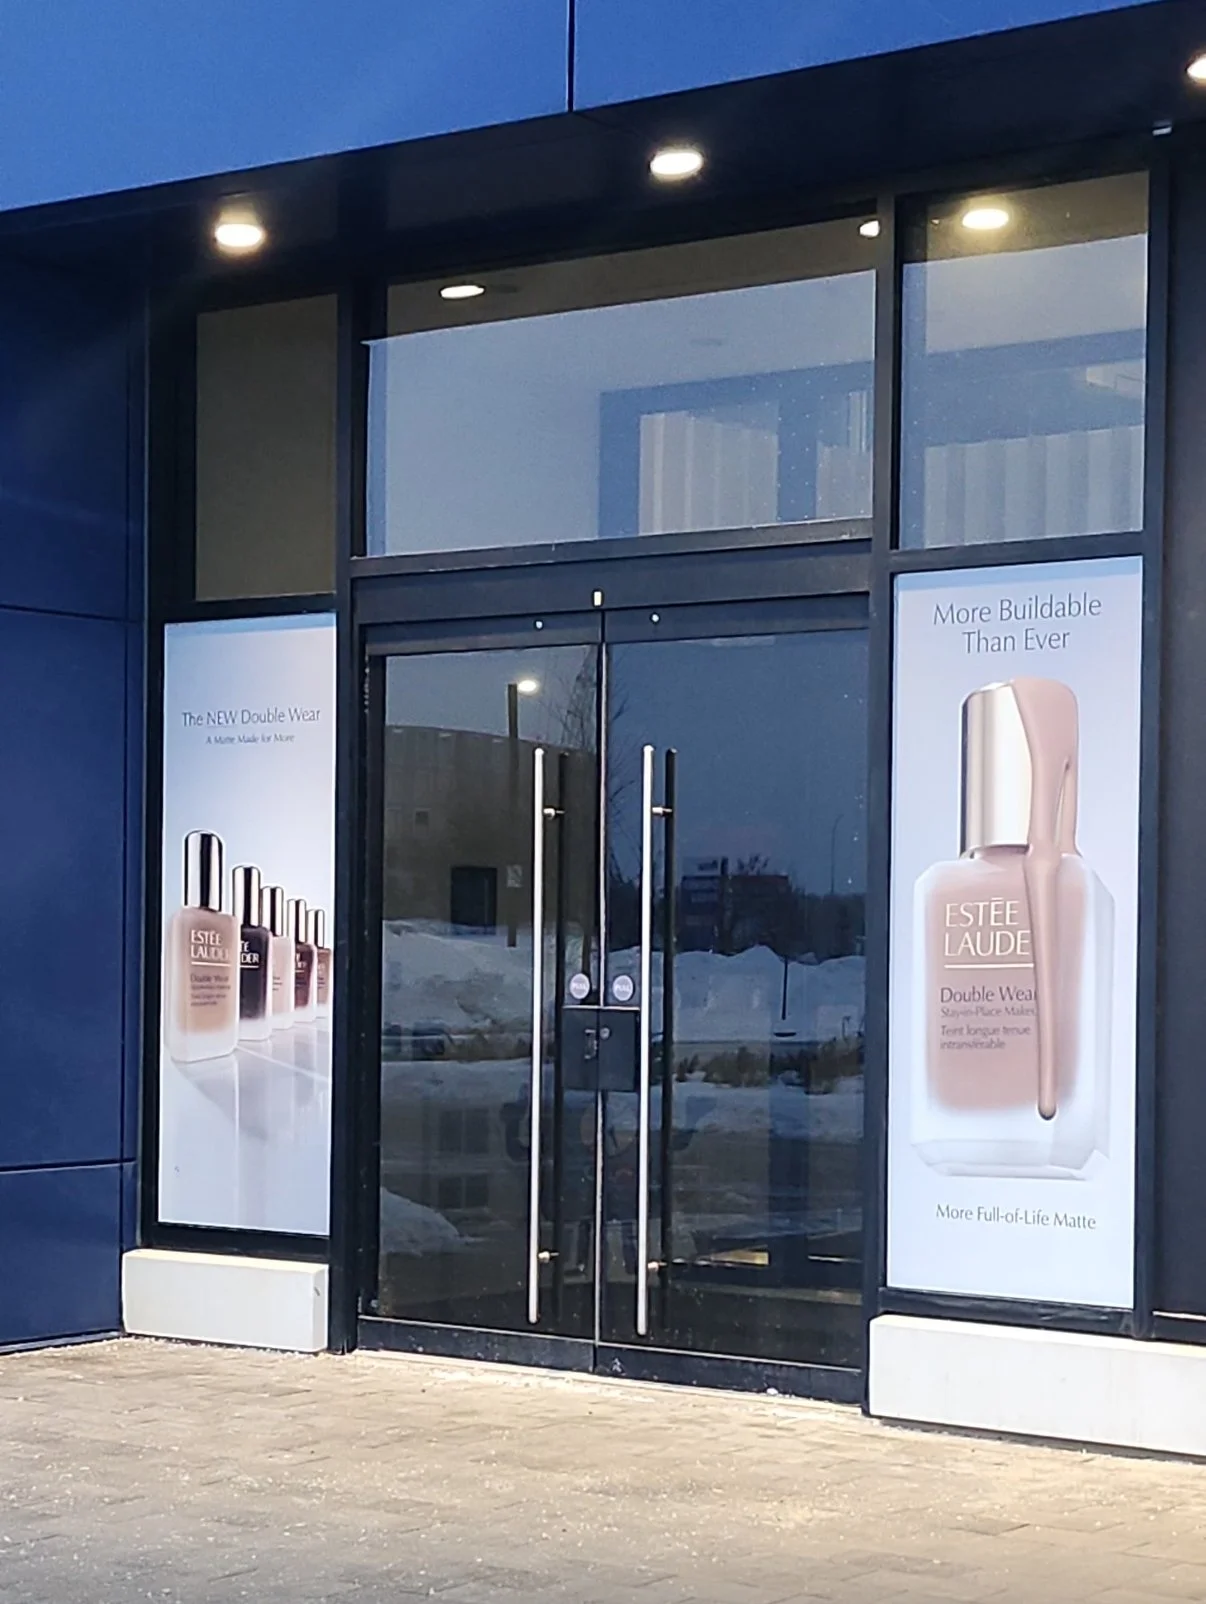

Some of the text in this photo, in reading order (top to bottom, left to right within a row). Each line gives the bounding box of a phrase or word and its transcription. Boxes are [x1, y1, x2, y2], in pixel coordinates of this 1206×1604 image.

[933, 591, 1102, 625] More Buildable
[962, 627, 1071, 654] Than Ever
[181, 706, 321, 727] The NEW Double Wear
[205, 735, 212, 745] A
[238, 734, 258, 744] Made
[260, 733, 272, 743] for
[273, 732, 295, 743] More
[943, 930, 1031, 957] LAUDE
[940, 985, 995, 1003] Double
[935, 1203, 1097, 1230] More Full-of-Life Matte
